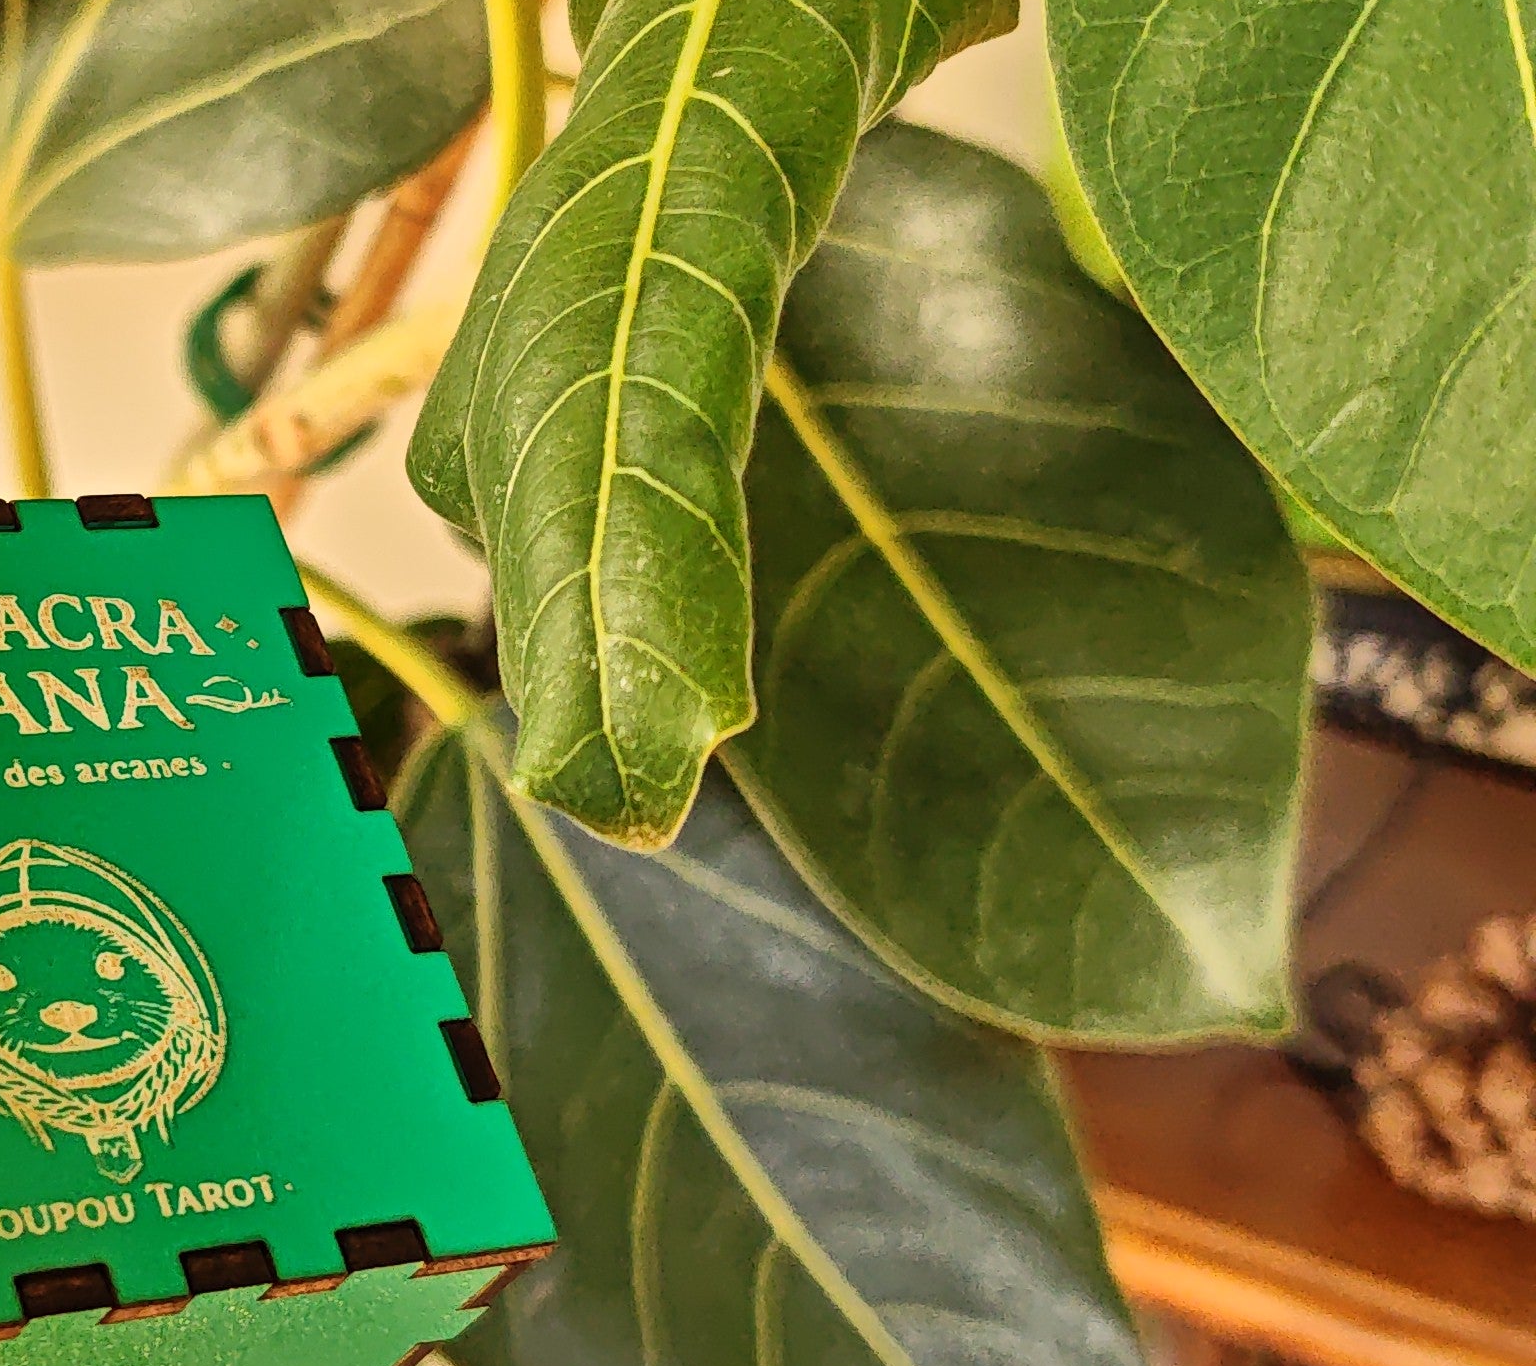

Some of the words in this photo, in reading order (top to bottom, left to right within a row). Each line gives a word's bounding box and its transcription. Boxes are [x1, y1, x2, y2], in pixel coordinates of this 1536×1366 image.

[4, 758, 66, 789] des
[75, 754, 209, 783] arcanes
[145, 1173, 276, 1219] TAROT
